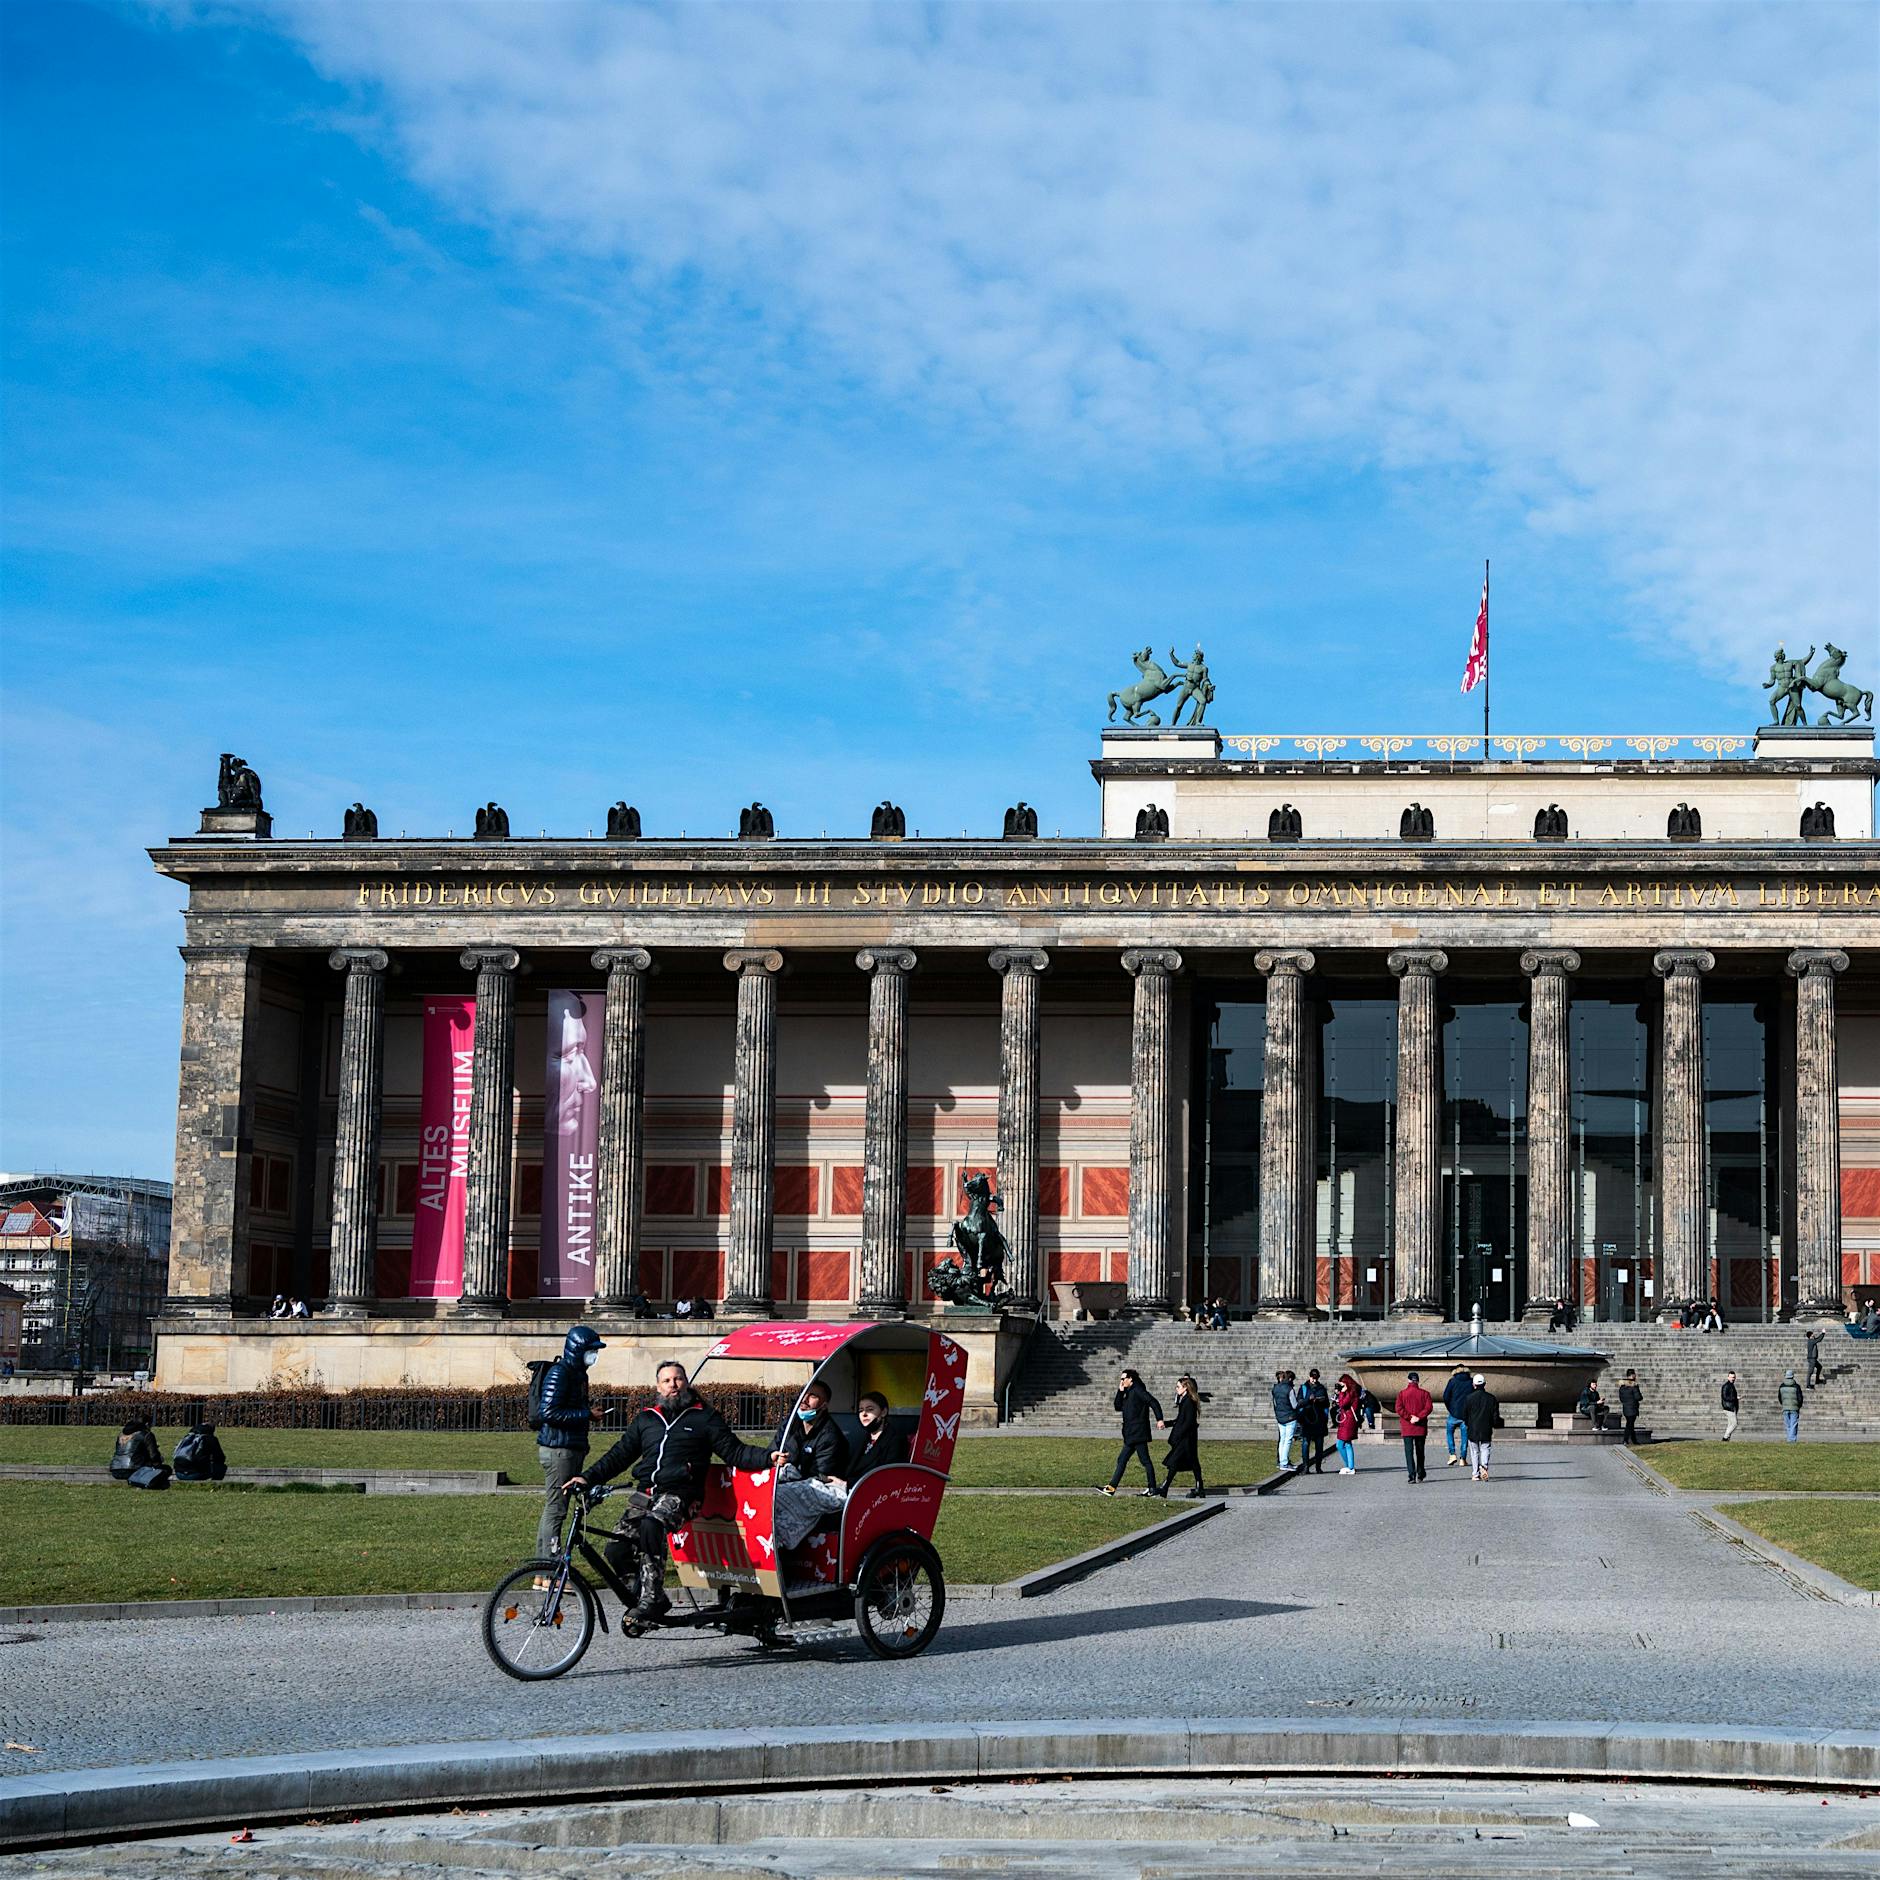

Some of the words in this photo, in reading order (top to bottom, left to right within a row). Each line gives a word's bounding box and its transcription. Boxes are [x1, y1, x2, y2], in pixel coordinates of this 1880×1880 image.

[357, 881, 556, 905] FRIDERICVS
[579, 881, 774, 905] GVILELMVS
[795, 881, 831, 905] III
[852, 881, 984, 905] STVDIO
[1006, 881, 1271, 905] ANTIQVITATIS
[1288, 881, 1519, 905] OMNIGENAE
[1538, 881, 1584, 905] ET
[1598, 881, 1739, 906] ARTIVM
[420, 1125, 449, 1212] ALTES
[567, 1153, 594, 1266] ANTIKE
